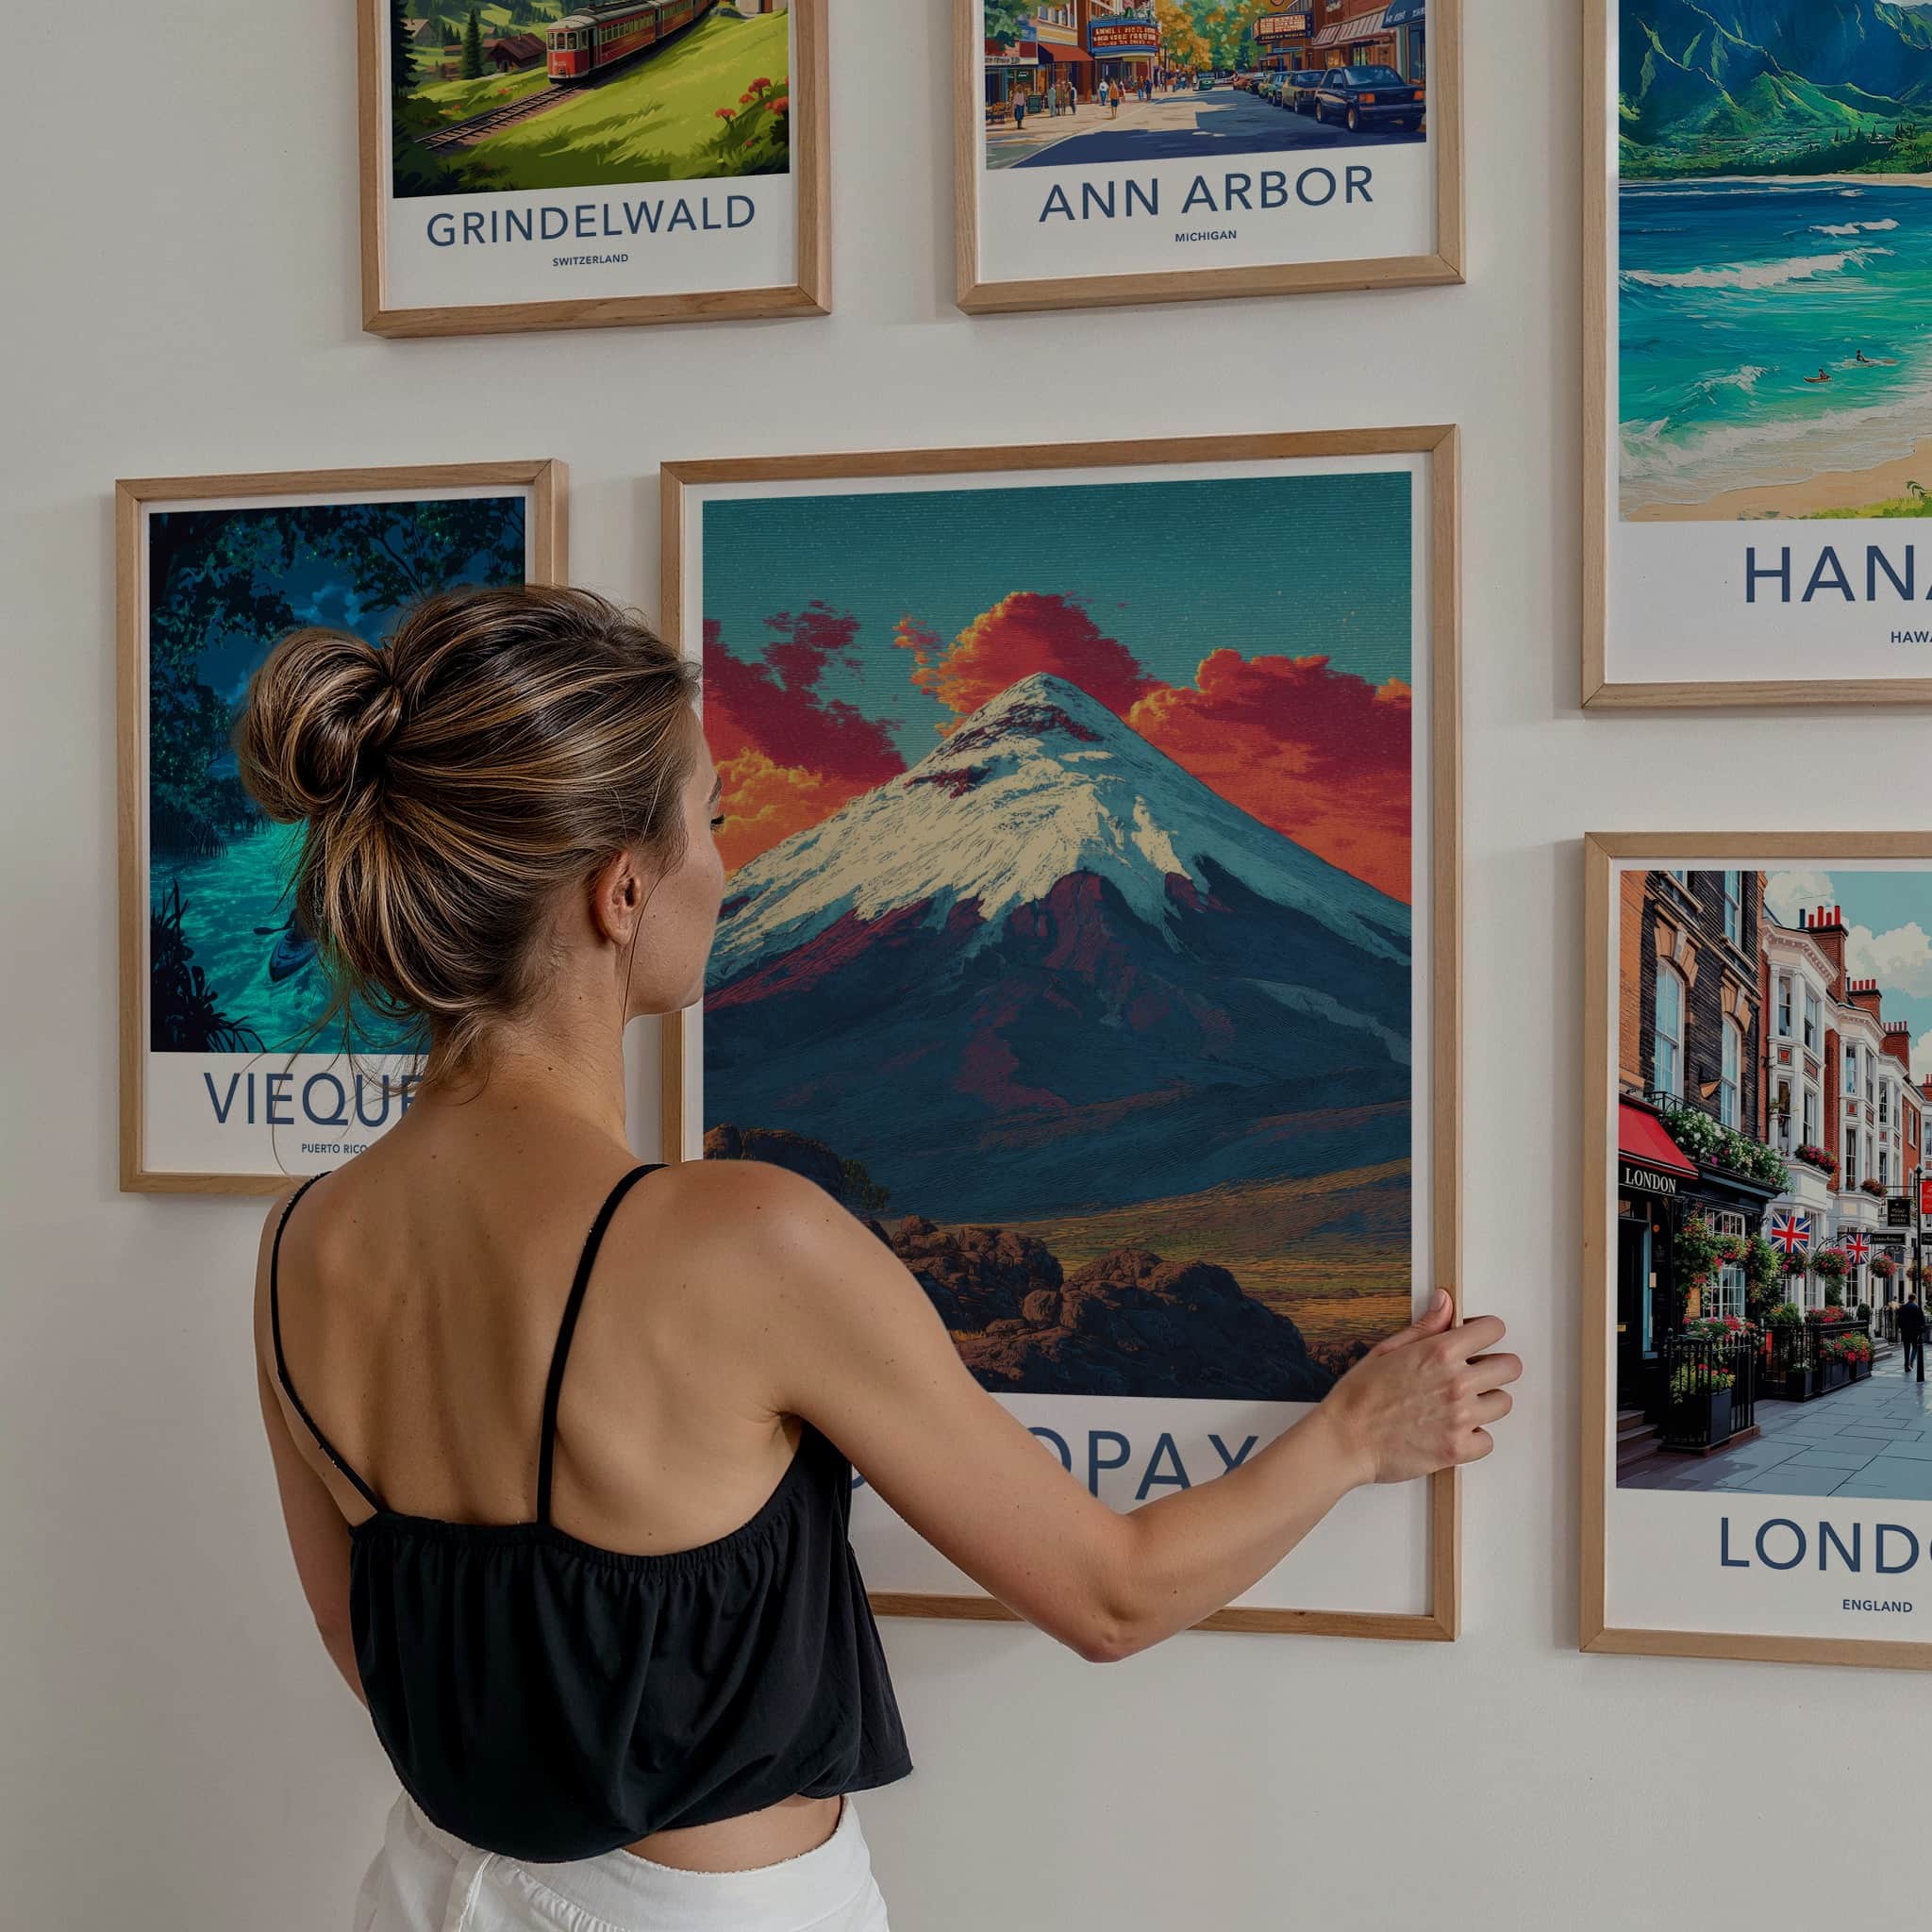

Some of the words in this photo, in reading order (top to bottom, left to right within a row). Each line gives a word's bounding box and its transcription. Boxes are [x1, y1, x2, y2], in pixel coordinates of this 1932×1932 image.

[1039, 177, 1158, 223] ANN
[1181, 165, 1374, 214] ARBOR
[427, 195, 755, 246] GRINDELWALD
[1174, 229, 1238, 242] MICHIGAN
[552, 253, 629, 267] SWITZERLAND
[1746, 544, 1932, 603] HAN
[1890, 630, 1932, 643] HAW
[301, 1143, 341, 1154] PUERTO
[1624, 1168, 1676, 1194] LONDON
[1721, 1517, 1932, 1574] LOND
[1842, 1598, 1913, 1613] ENGLAND
